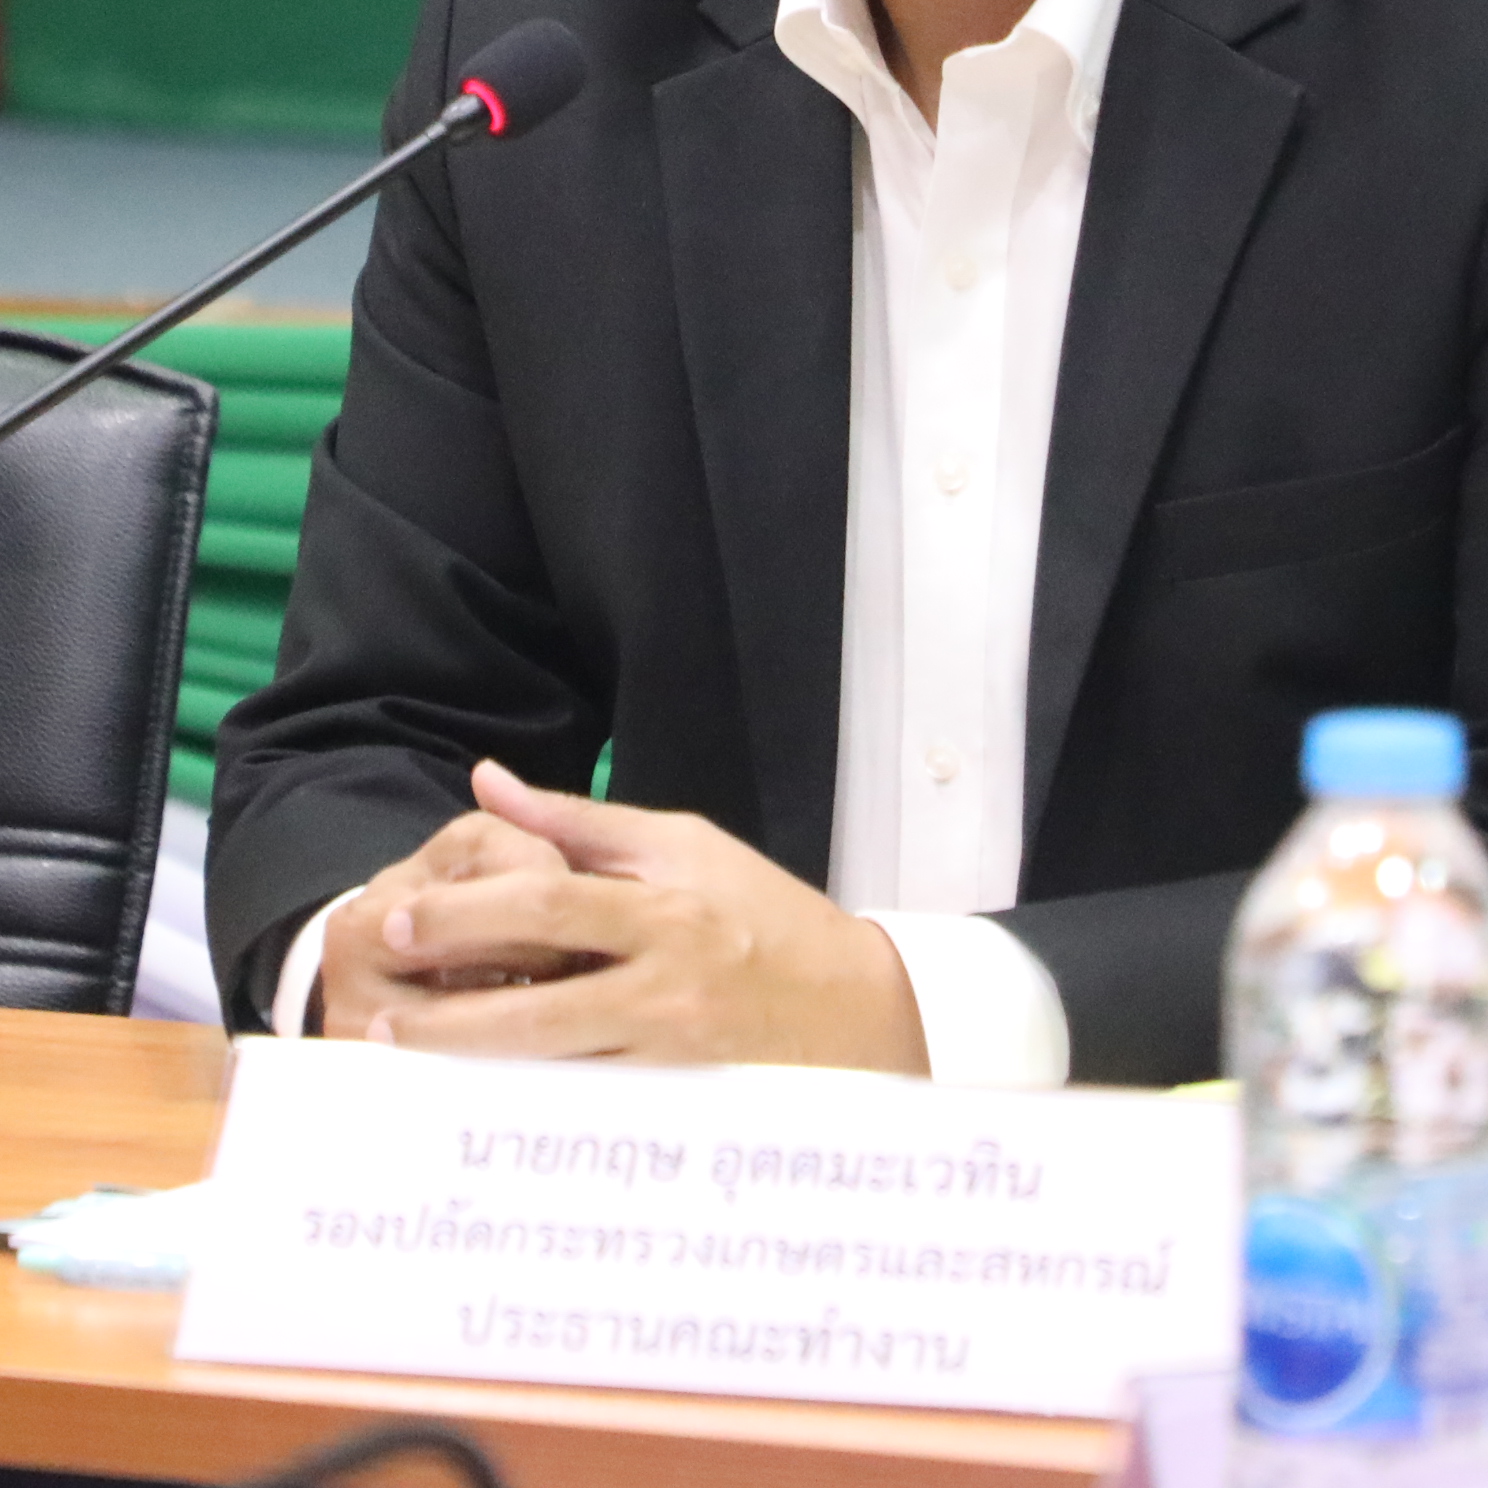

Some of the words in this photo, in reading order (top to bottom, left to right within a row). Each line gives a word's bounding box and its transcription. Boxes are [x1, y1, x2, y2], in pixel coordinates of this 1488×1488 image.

[454, 1126, 690, 1190] นายกฤษ
[303, 1196, 1174, 1298] รองปลัดกระทรวงเกษตรและสหกรณ์
[457, 1295, 970, 1376] ประธานคณะทำงาน
